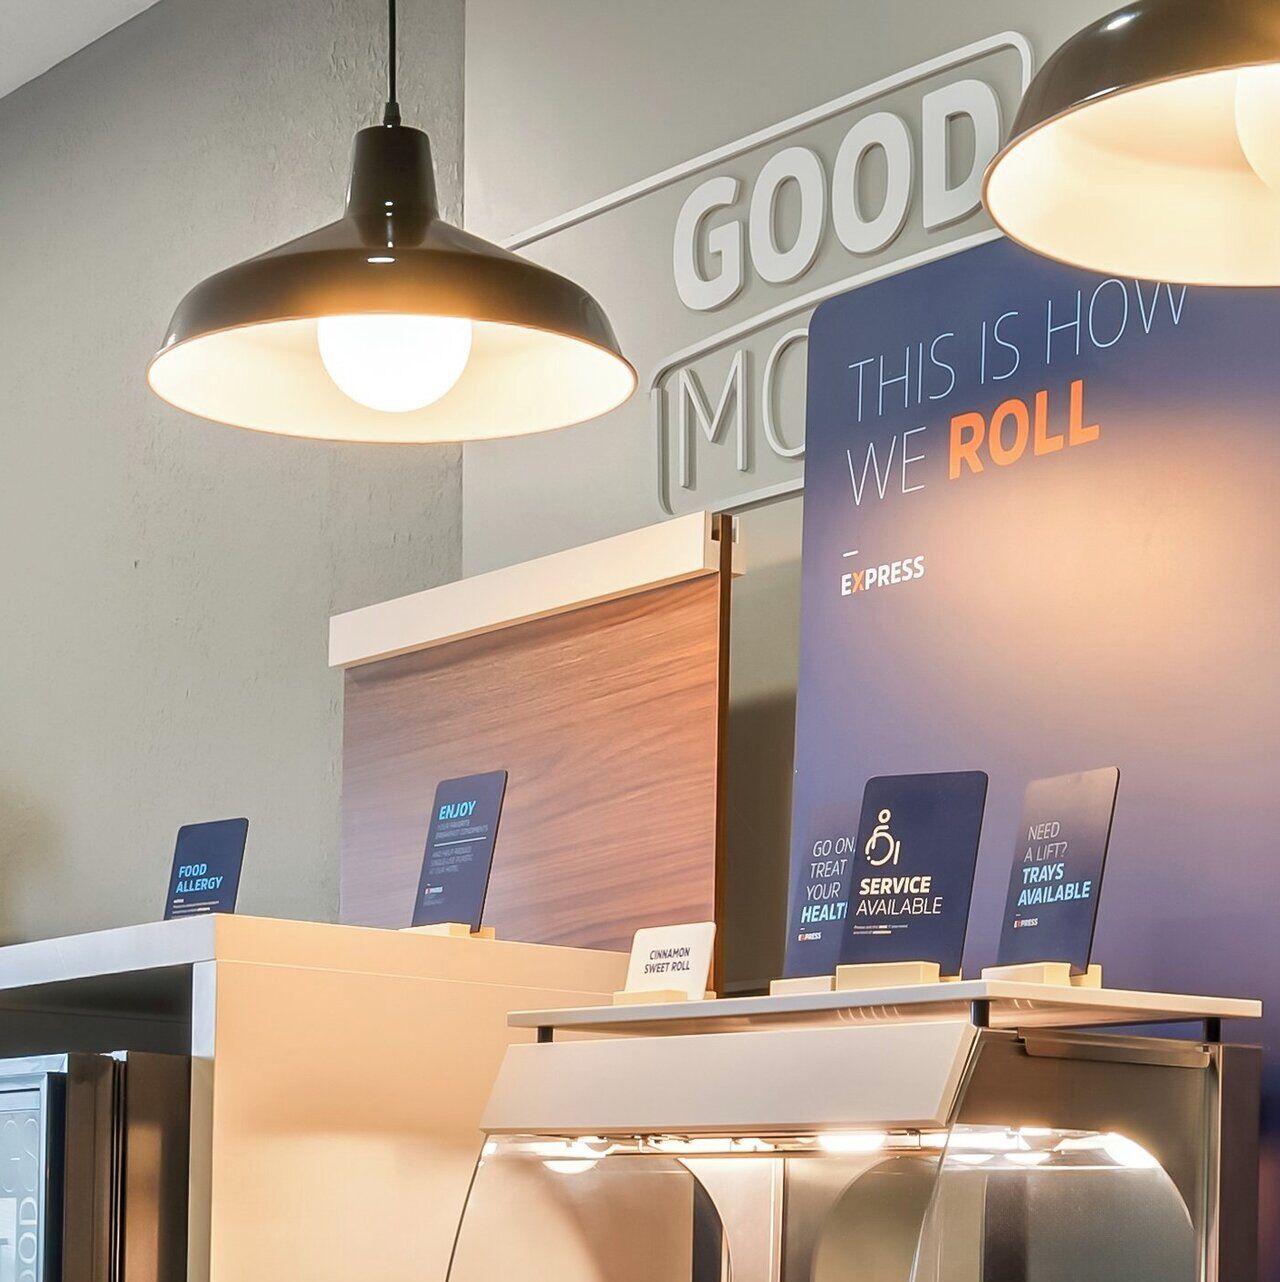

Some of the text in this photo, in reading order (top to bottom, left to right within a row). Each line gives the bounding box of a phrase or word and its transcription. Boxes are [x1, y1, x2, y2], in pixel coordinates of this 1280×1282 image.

[673, 79, 1001, 311] GOOD
[848, 278, 1187, 422] THIS IS HOW
[846, 378, 1101, 506] WE ROLL
[841, 555, 925, 597] EXPRESS
[438, 800, 477, 821] ENJOY
[1027, 821, 1061, 841] NEED
[812, 839, 832, 858] GO
[1023, 841, 1068, 863] A LIFT?
[178, 863, 208, 879] FOOD
[810, 858, 848, 879] TREAT
[1022, 862, 1065, 884] TRAYS
[175, 875, 224, 894] ALLERGY
[806, 881, 841, 901] YOUR
[858, 875, 932, 896] SERVICE
[1017, 880, 1092, 907] AVAILABLE
[855, 896, 944, 916] AVAILABLE
[649, 946, 691, 961] CINNAMON
[643, 960, 691, 974] SWEET ROLL
